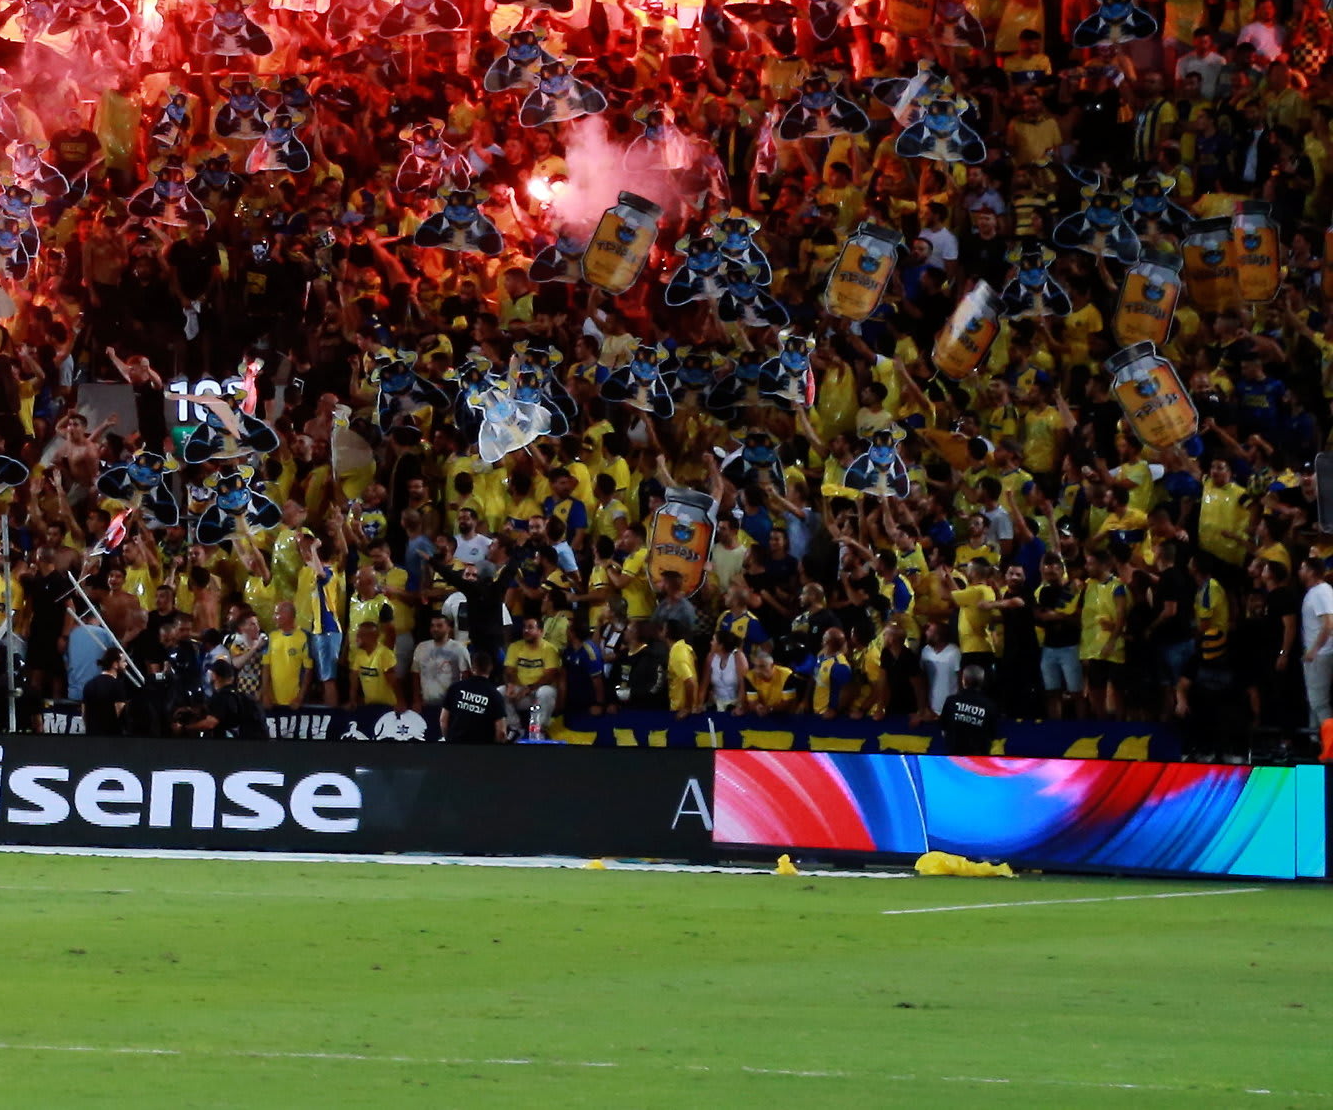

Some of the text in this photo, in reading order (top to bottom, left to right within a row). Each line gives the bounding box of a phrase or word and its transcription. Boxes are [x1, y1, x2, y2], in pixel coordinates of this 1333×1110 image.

[460, 690, 489, 706] מטאור
[457, 701, 486, 714] אבטחה
[955, 702, 985, 717] מטאור
[954, 713, 983, 727] אבטחה
[672, 778, 713, 831] A
